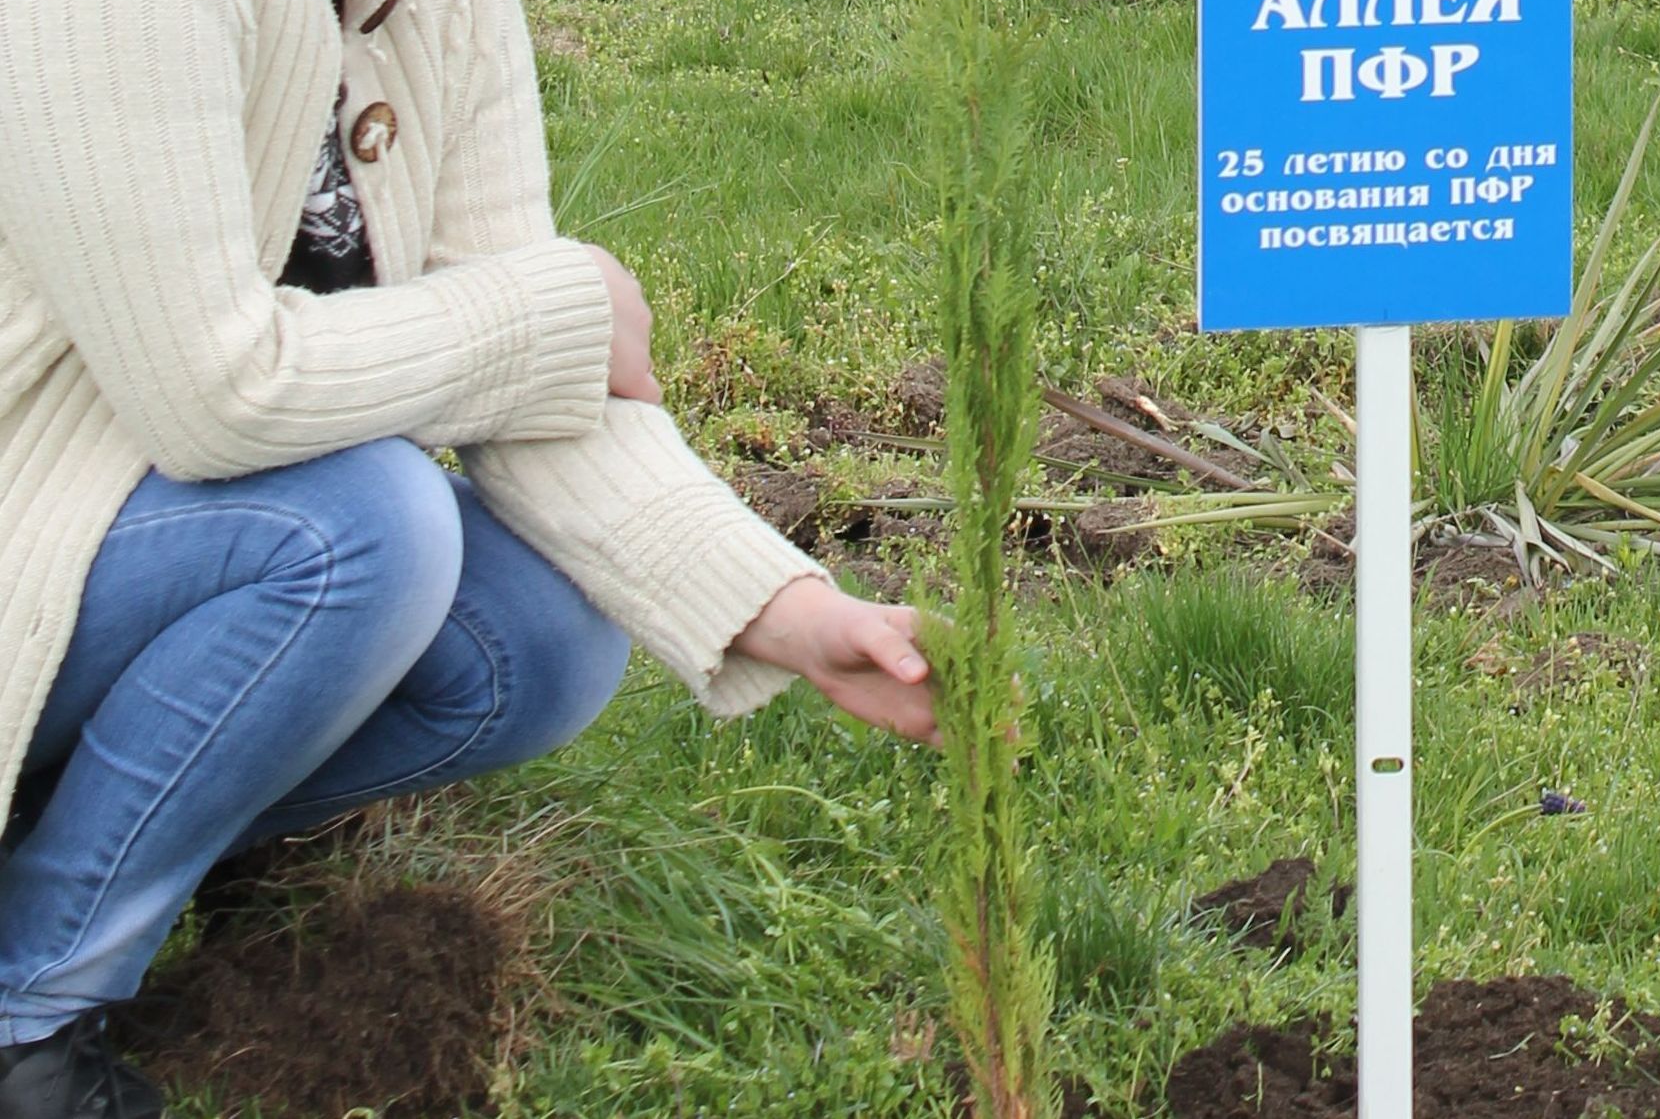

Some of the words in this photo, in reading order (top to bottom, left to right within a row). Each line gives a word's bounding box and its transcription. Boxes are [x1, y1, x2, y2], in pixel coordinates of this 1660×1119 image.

[1300, 43, 1480, 102] ПФР
[1217, 149, 1265, 178] 25
[1283, 150, 1406, 175] летию
[1424, 147, 1469, 170] со
[1485, 144, 1557, 172] дня
[1220, 185, 1430, 214] основания
[1450, 175, 1534, 205] ПФР
[1260, 218, 1514, 249] посвящается
